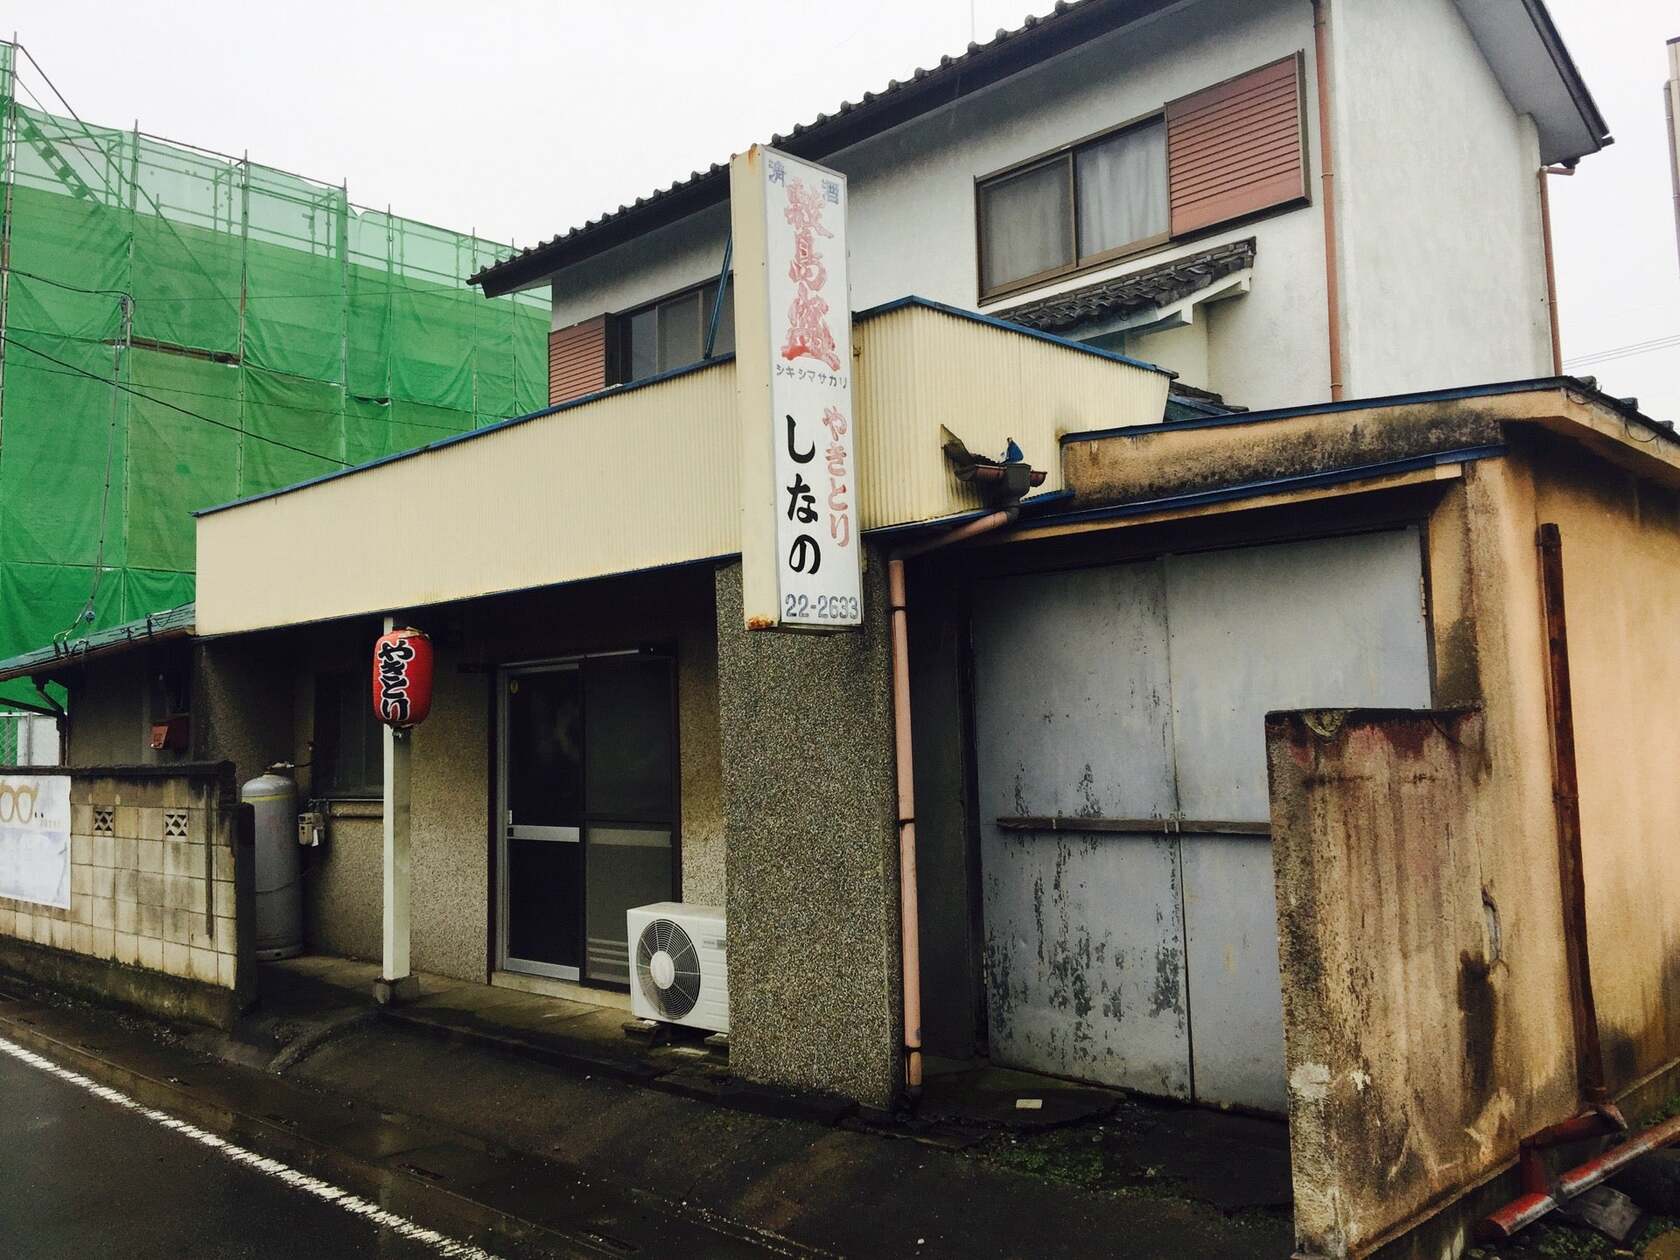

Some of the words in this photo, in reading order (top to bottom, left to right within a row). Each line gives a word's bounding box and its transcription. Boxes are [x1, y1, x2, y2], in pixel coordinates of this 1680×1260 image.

[776, 364, 847, 389] シキシマサカリ
[786, 414, 821, 574] しなの
[823, 406, 850, 547] やきとり
[785, 594, 858, 619] 22-2633
[378, 639, 415, 720] やきとり
